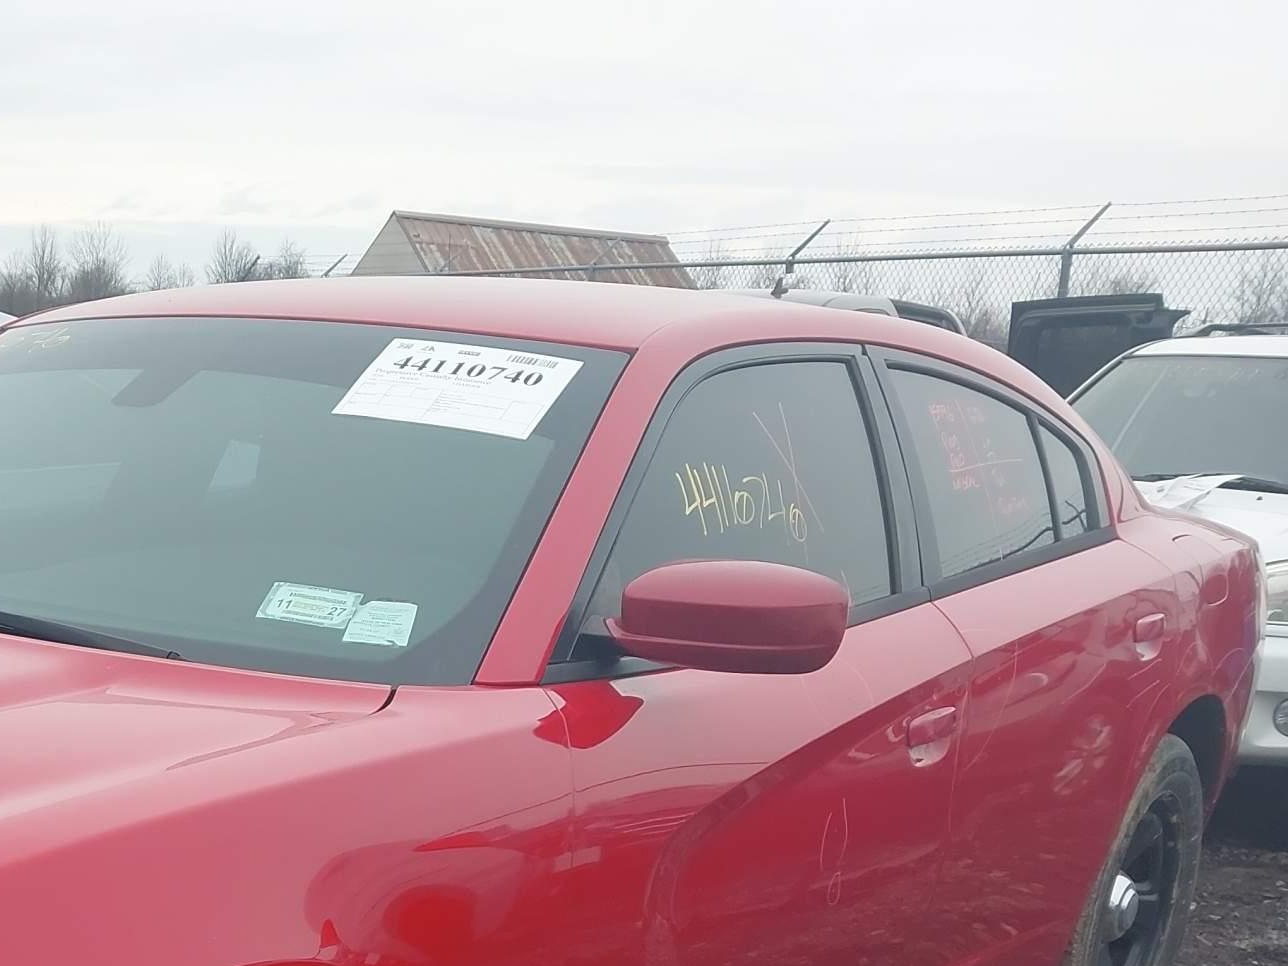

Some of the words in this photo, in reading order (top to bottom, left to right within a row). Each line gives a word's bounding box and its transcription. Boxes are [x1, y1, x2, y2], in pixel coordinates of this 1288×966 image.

[392, 354, 545, 387] 44110740
[275, 598, 293, 610] 11
[326, 606, 347, 617] 27
